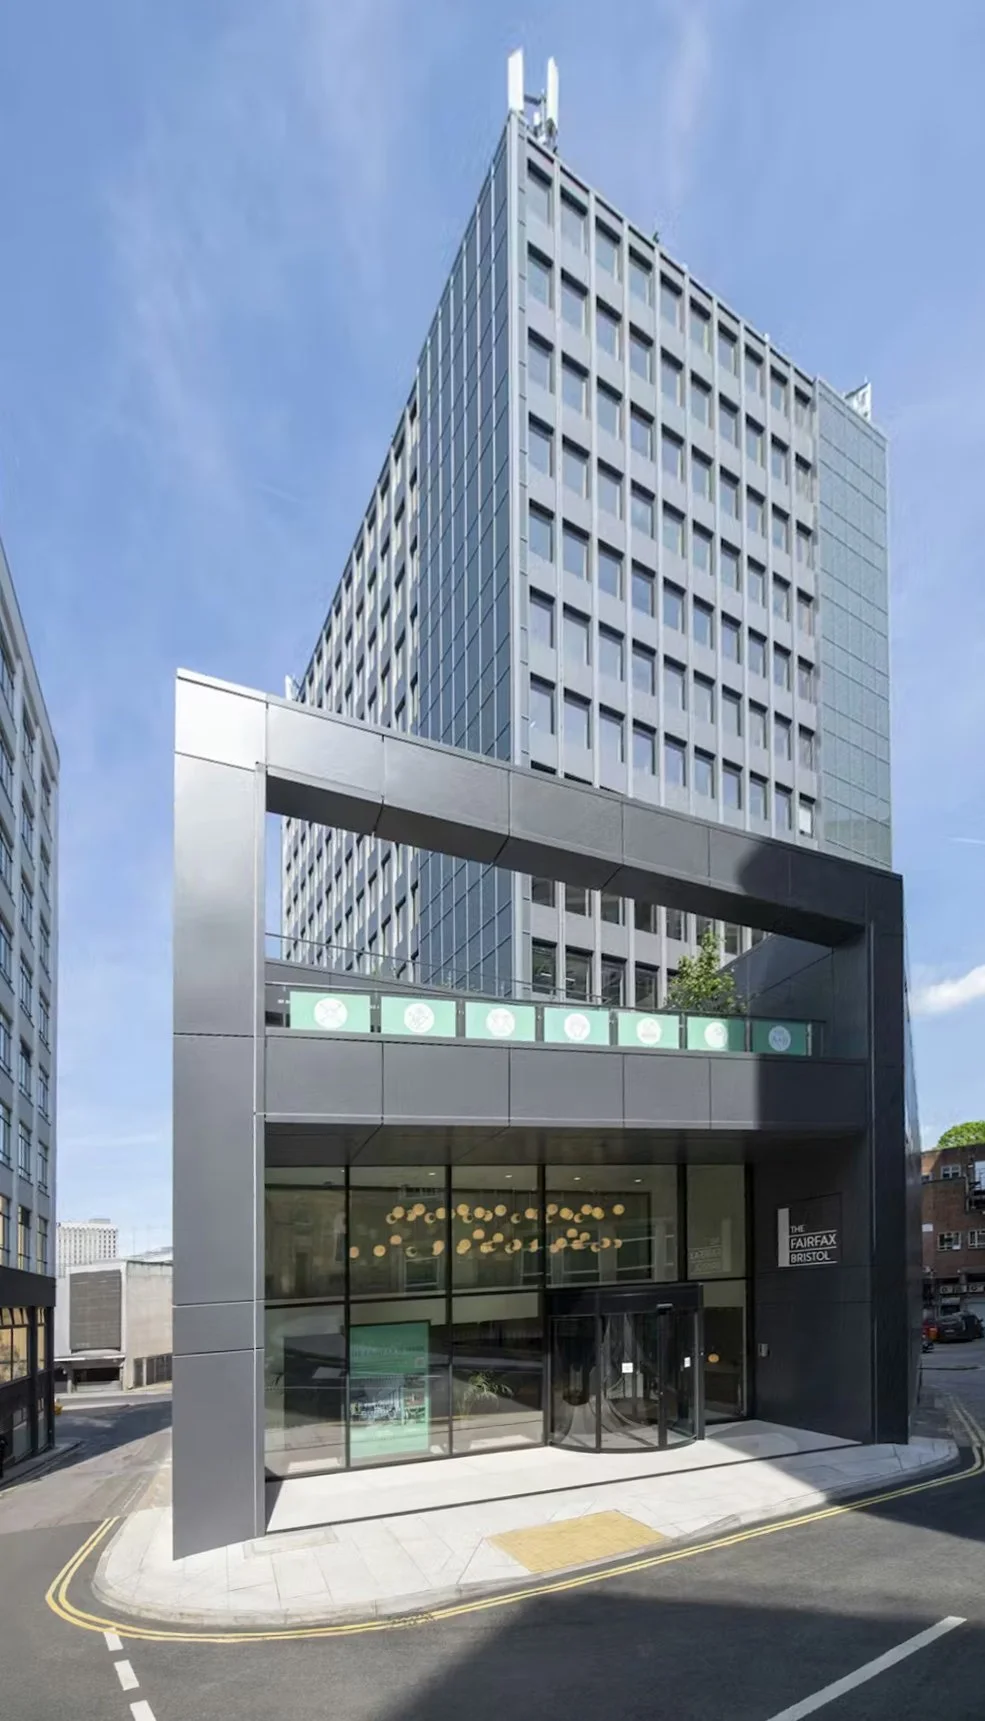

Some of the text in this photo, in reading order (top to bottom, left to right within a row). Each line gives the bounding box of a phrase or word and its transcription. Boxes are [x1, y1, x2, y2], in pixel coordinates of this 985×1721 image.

[791, 1225, 806, 1233] THE
[791, 1234, 837, 1249] FAIRFAX
[791, 1251, 831, 1263] BRISTOL
